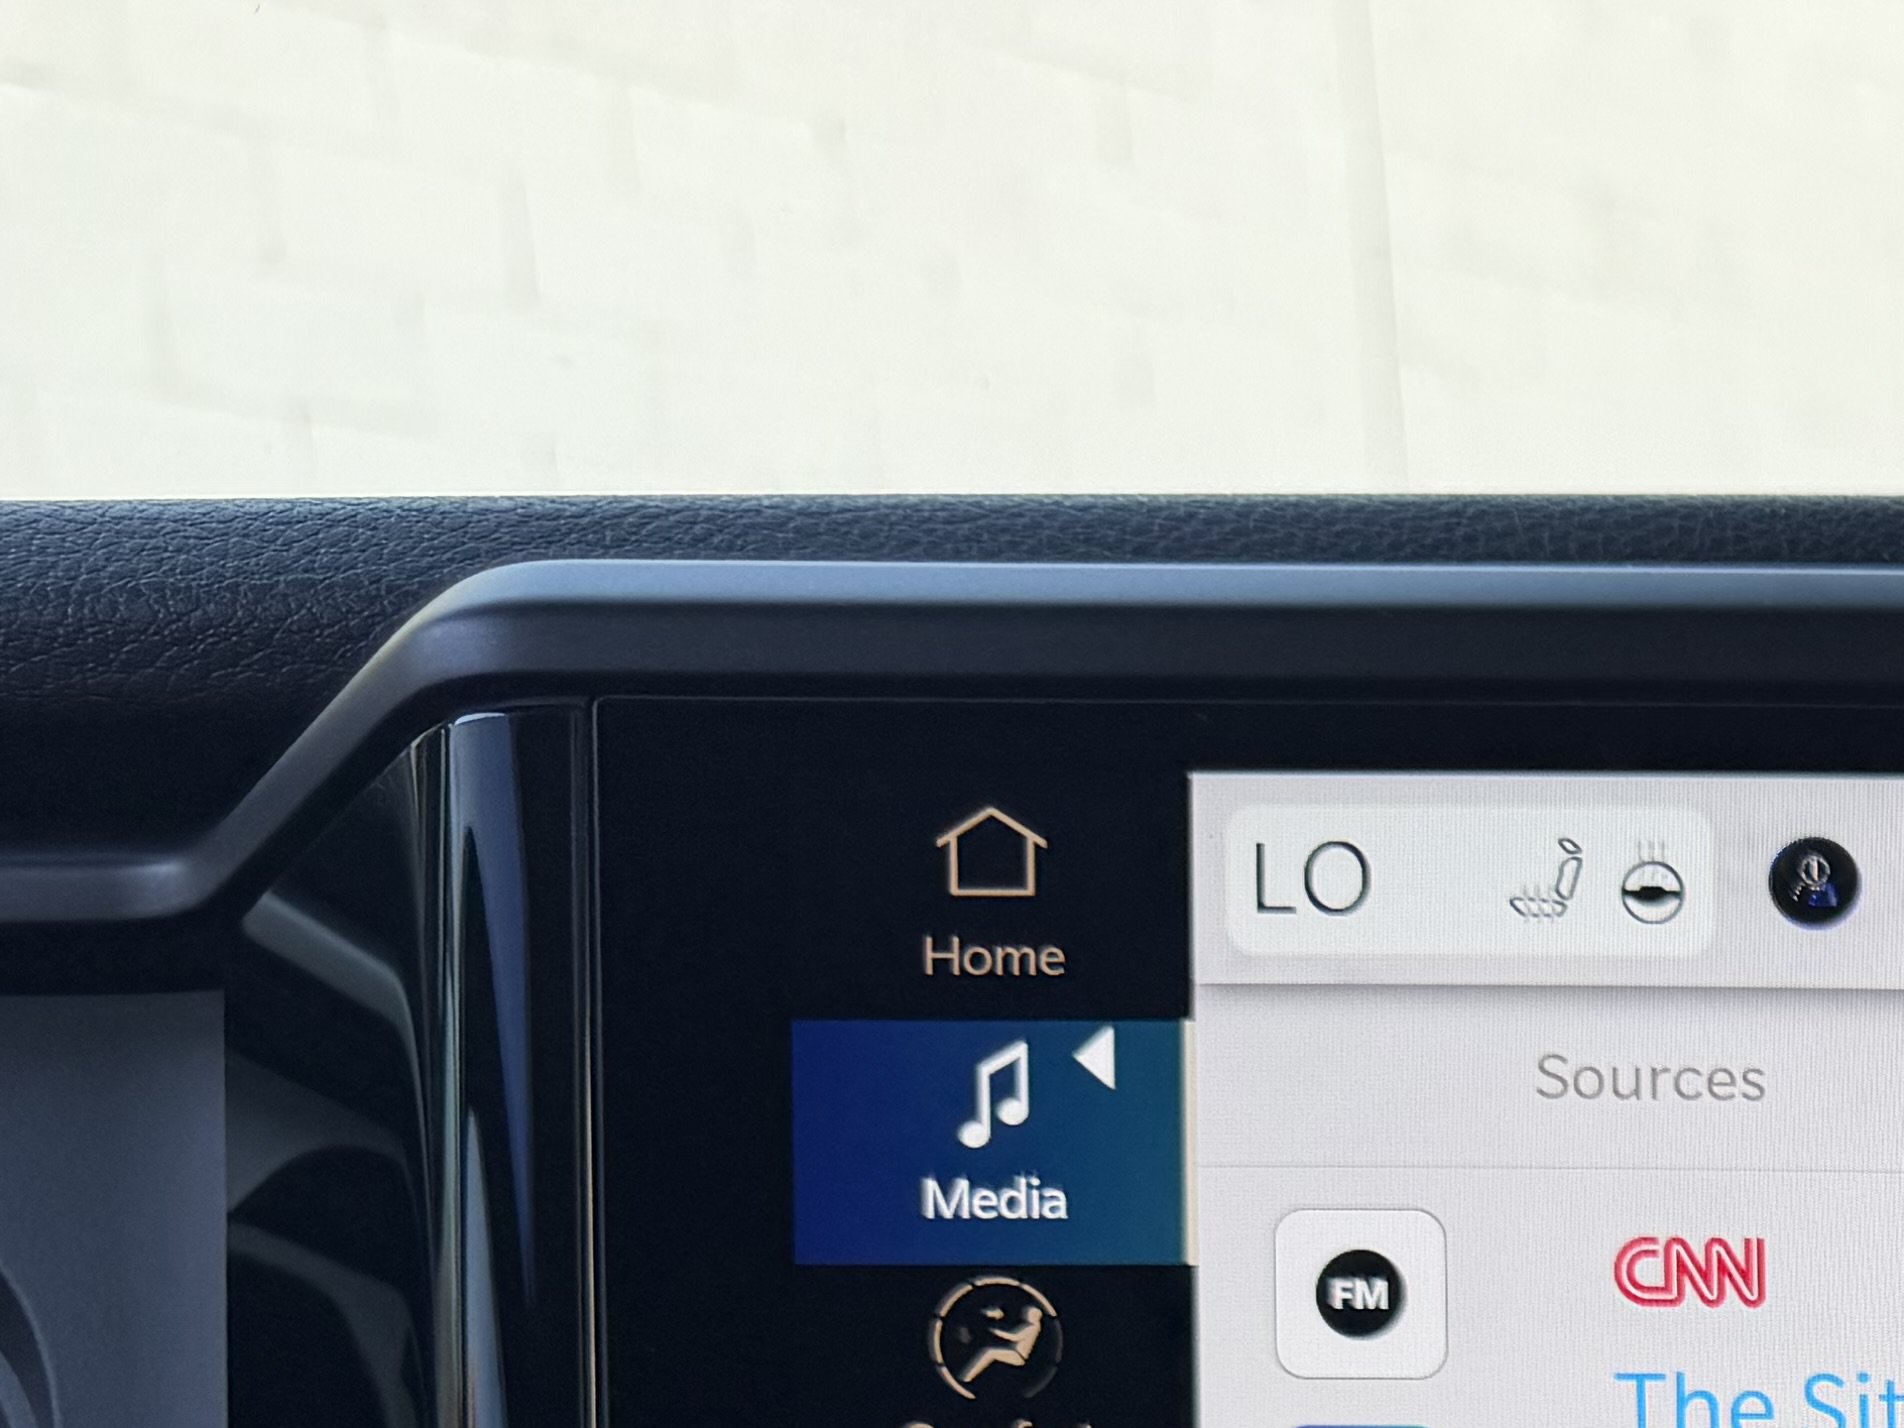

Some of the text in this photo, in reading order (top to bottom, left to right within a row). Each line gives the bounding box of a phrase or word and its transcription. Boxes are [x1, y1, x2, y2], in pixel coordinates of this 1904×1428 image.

[1255, 839, 1373, 917] LO
[923, 934, 1066, 977] Home
[1536, 1053, 1766, 1102] Sources
[921, 1177, 1068, 1220] Media
[1326, 1279, 1389, 1311] FM
[1613, 1236, 1765, 1308] CNN
